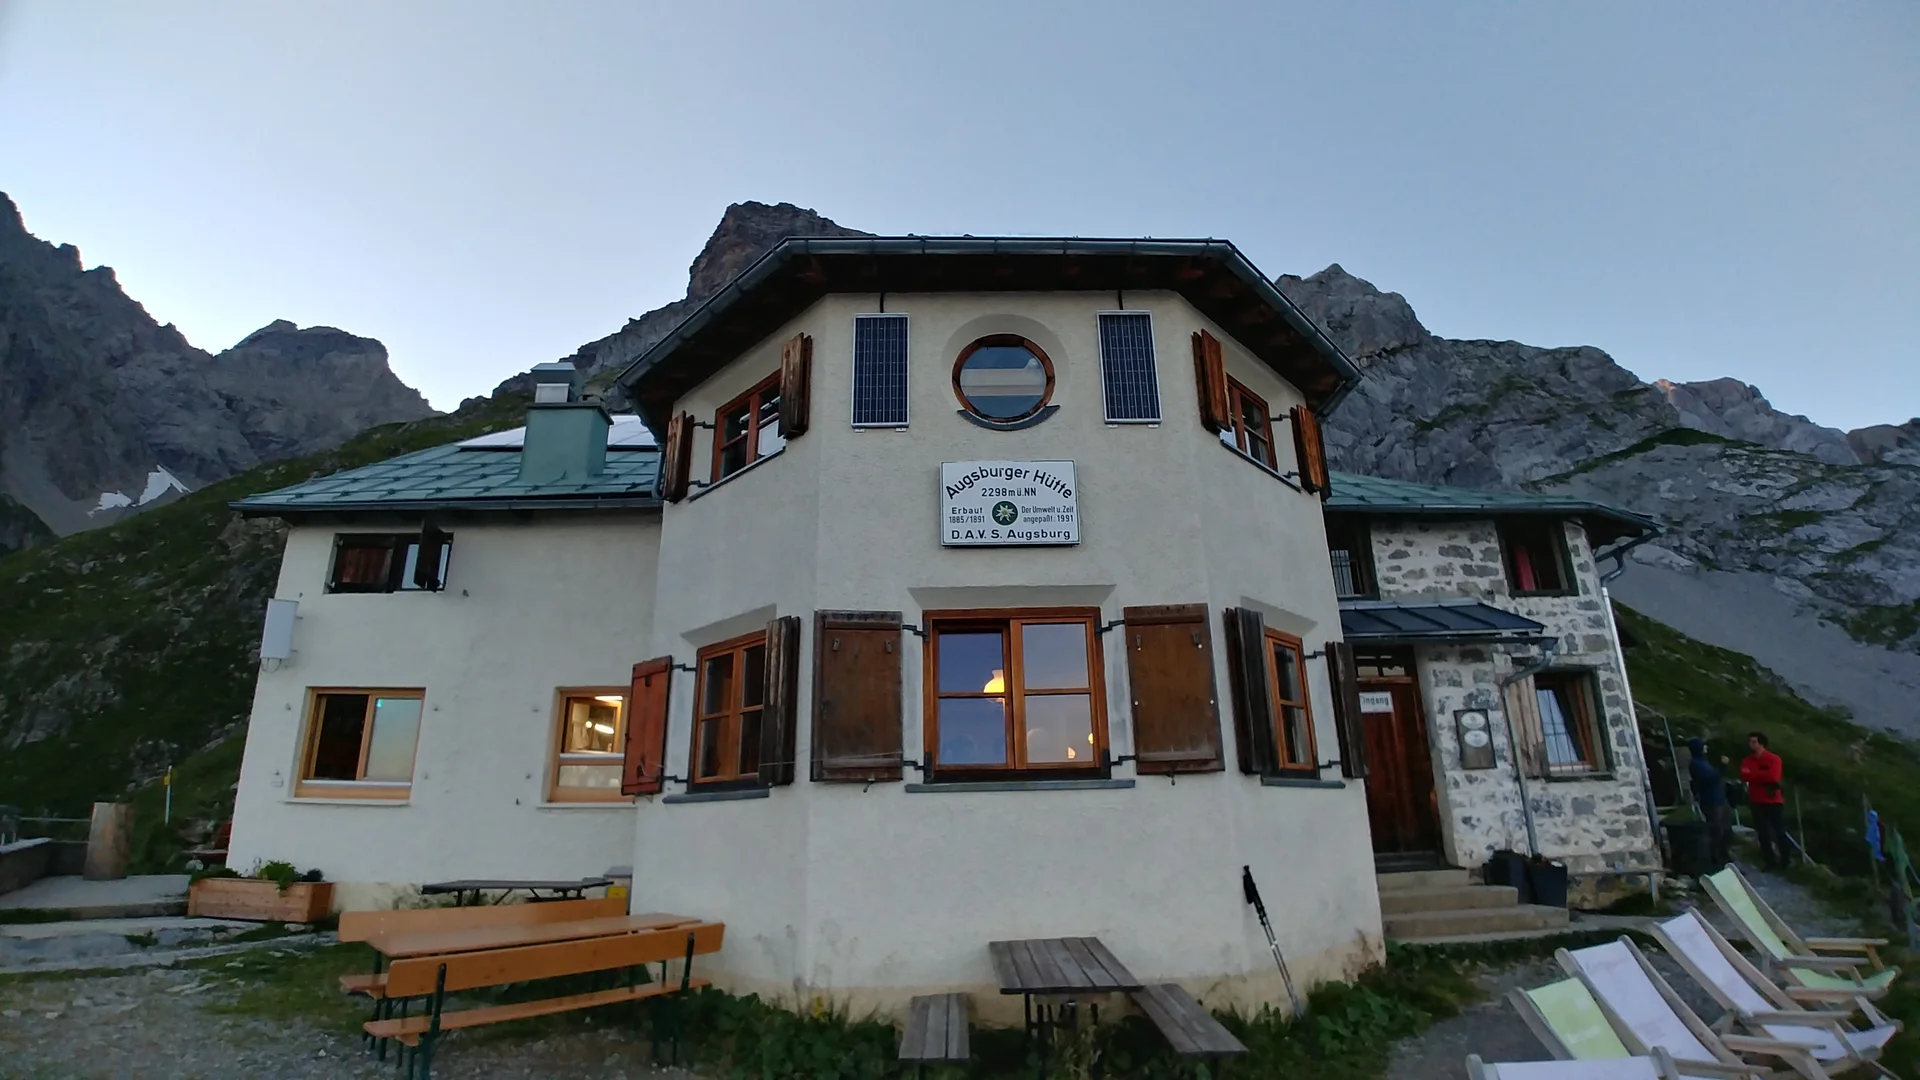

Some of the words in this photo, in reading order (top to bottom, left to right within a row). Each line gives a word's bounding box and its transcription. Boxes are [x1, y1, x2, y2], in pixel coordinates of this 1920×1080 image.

[946, 466, 1030, 500] Augsburger
[1033, 470, 1072, 499] Hütte
[991, 530, 1002, 539] S.
[1007, 529, 1070, 540] Augsburg
